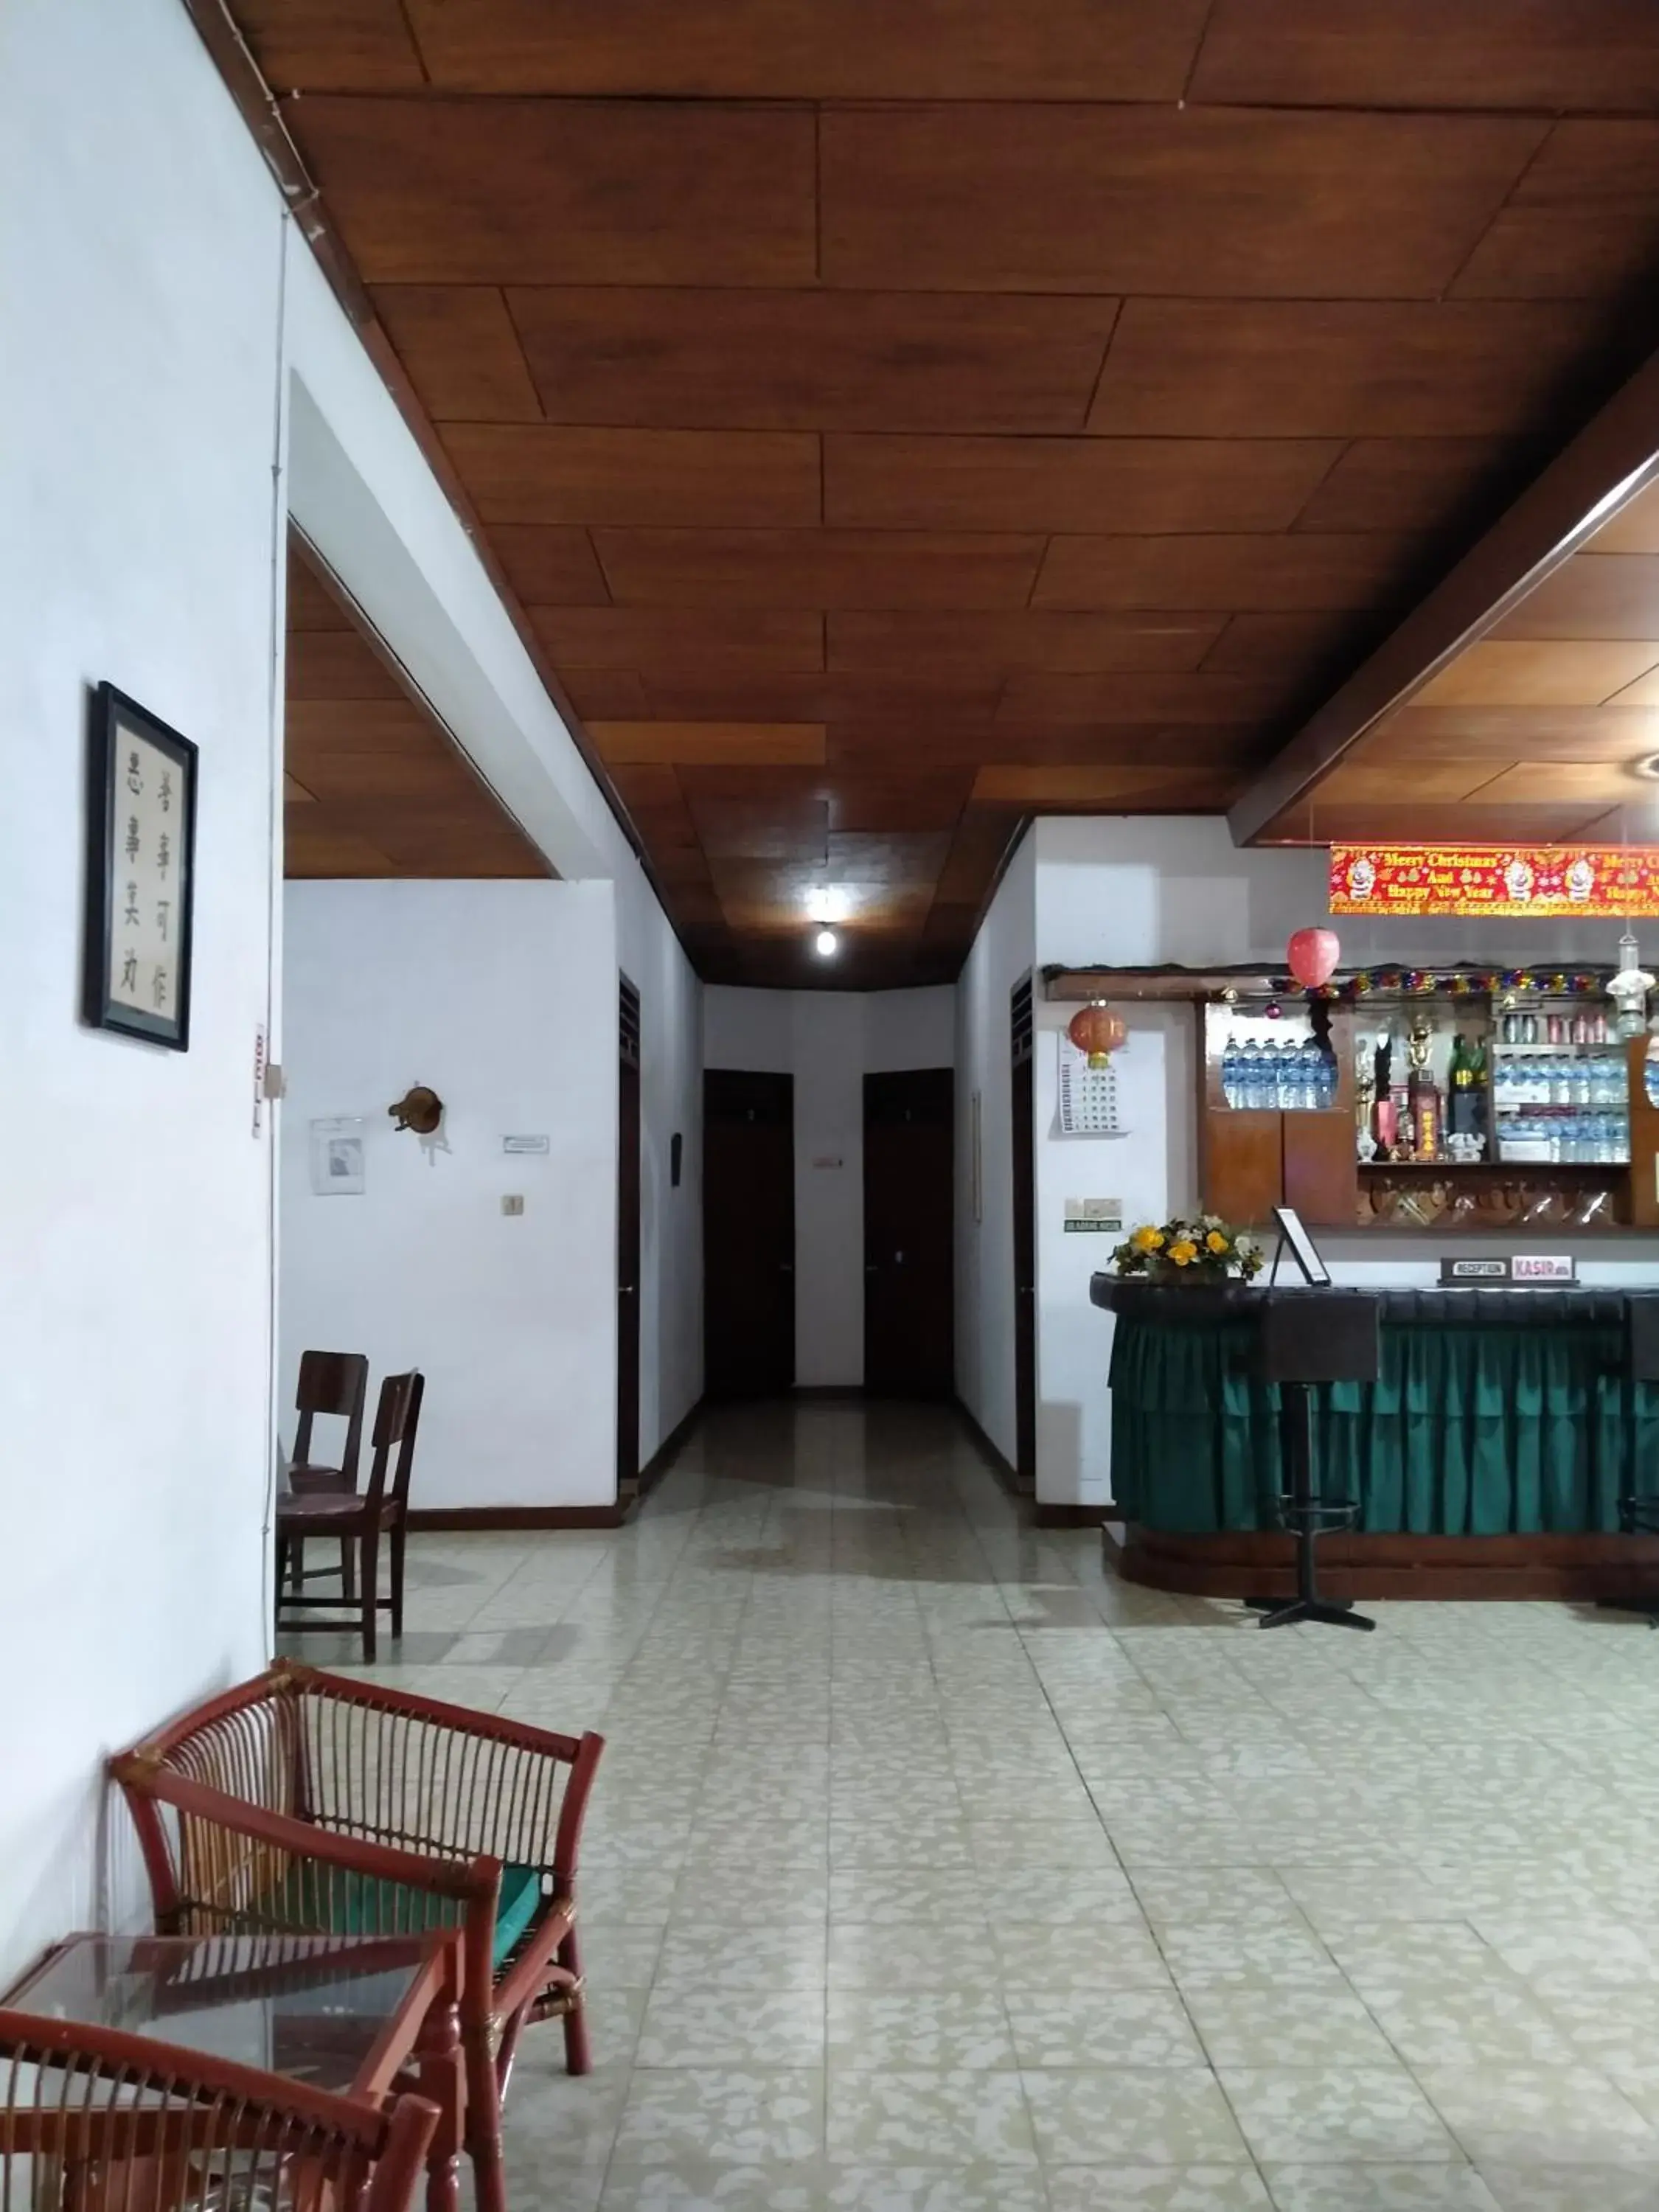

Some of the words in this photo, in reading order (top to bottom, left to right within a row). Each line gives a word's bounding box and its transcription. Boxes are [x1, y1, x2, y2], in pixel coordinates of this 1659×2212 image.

[1384, 853, 1425, 868] Merry
[1427, 853, 1498, 867] Christmas
[1388, 885, 1430, 900] Happy
[1434, 885, 1461, 898] New
[1464, 885, 1493, 899] Year
[1457, 1263, 1502, 1274] RECEPTION
[1515, 1260, 1554, 1276] KASIR
